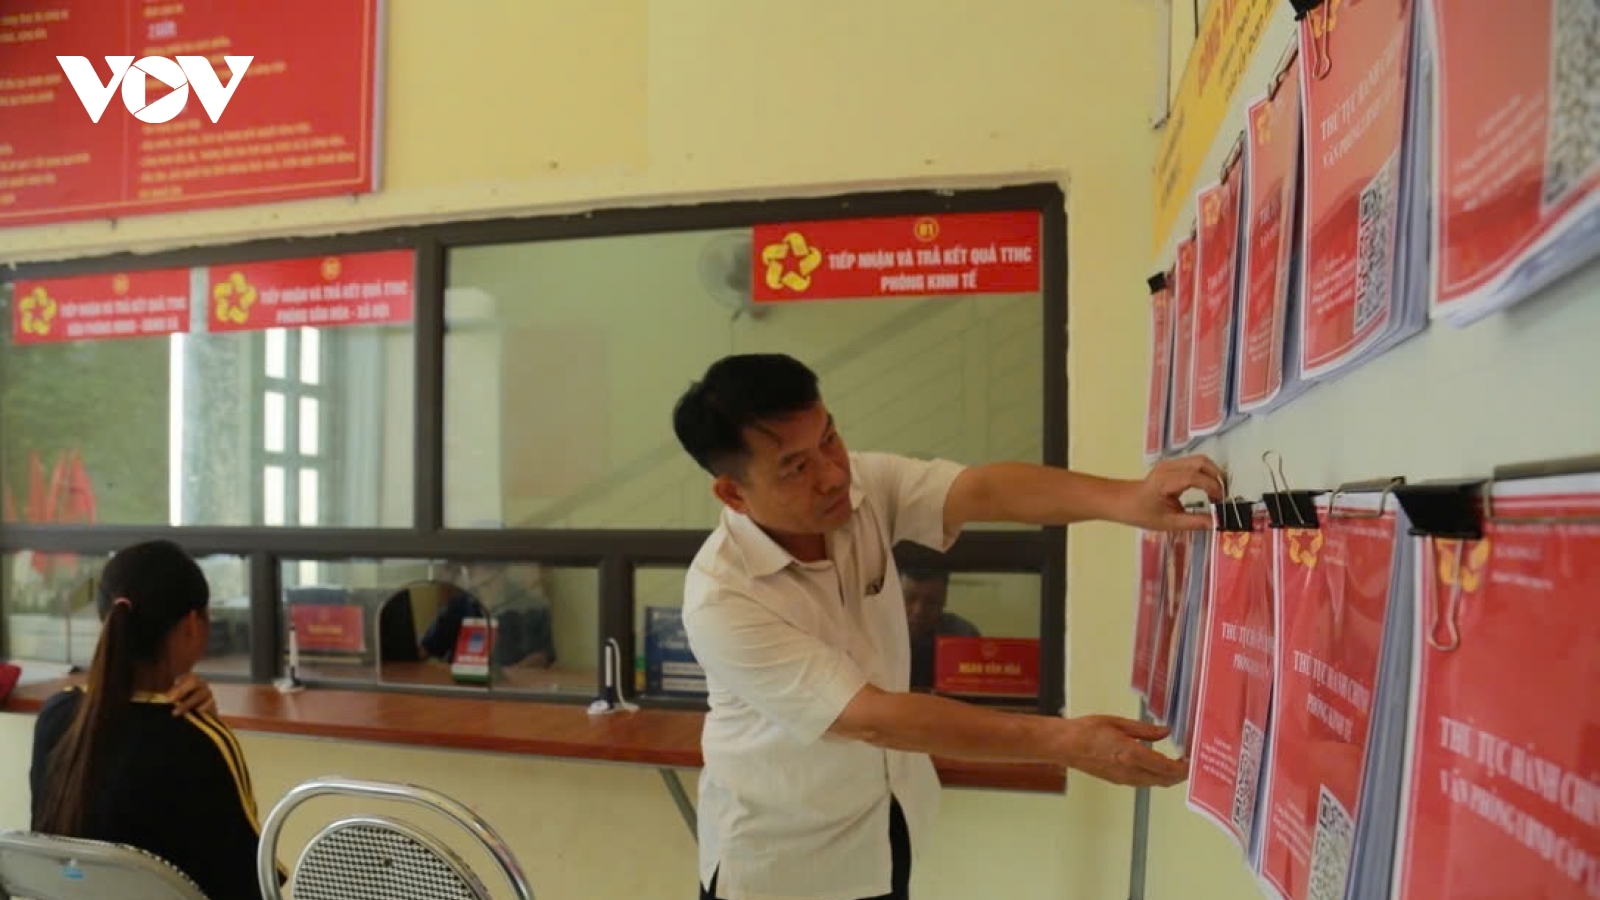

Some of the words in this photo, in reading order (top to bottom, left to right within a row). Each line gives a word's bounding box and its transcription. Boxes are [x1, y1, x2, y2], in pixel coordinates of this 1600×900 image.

[828, 249, 857, 270] TIẾP
[858, 247, 895, 271] NHẬN
[896, 246, 914, 267] VÀ
[917, 244, 941, 266] TRẢ
[943, 244, 967, 265] KẾT
[970, 242, 997, 265] QUẢ
[1000, 246, 1032, 264] TTHC
[880, 272, 925, 292] PHÒNG
[927, 272, 959, 290] KINH
[962, 267, 978, 289] TẾ
[1439, 714, 1473, 758] THỦ
[1477, 730, 1511, 778] TỤC
